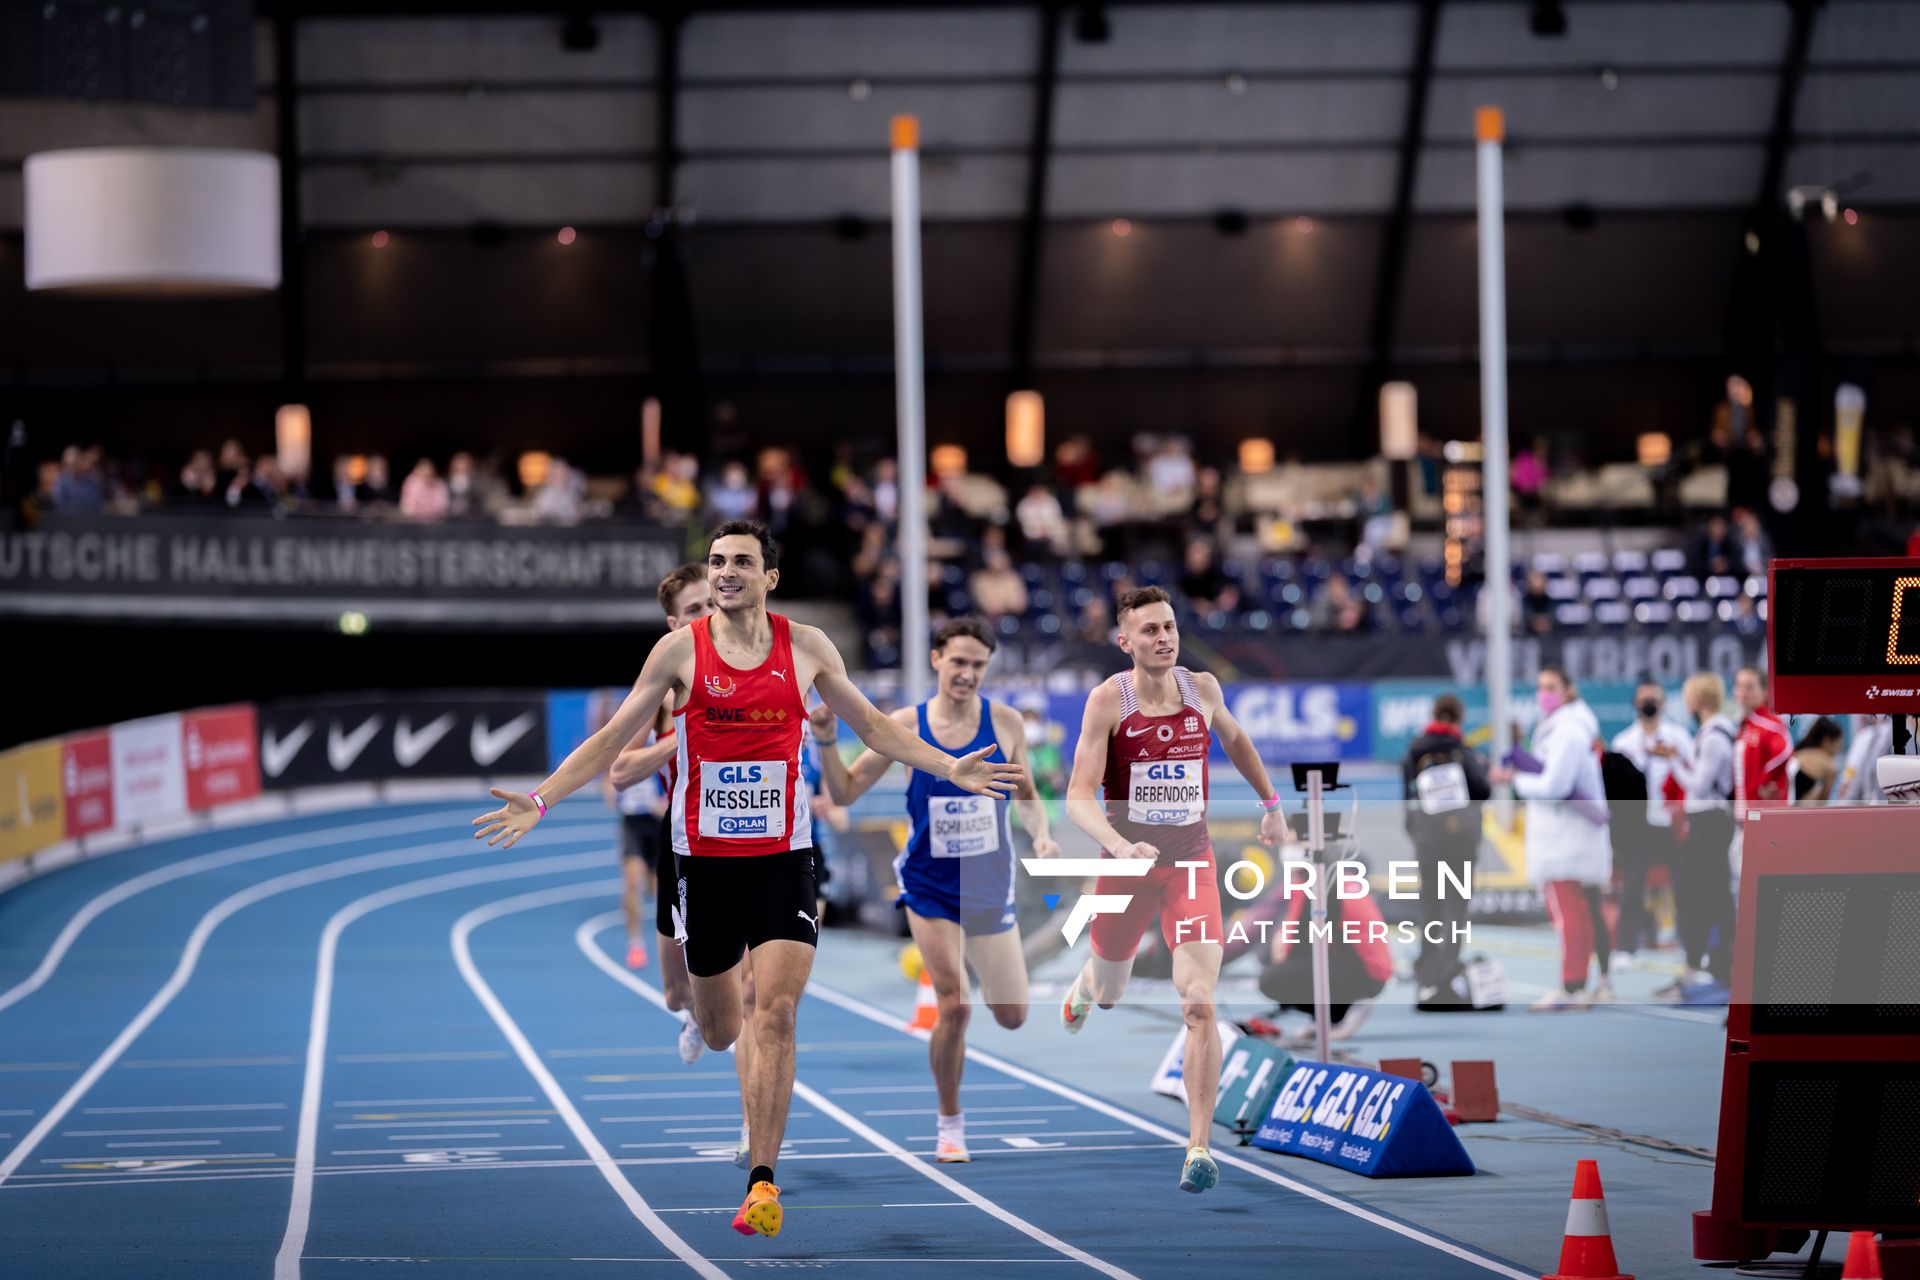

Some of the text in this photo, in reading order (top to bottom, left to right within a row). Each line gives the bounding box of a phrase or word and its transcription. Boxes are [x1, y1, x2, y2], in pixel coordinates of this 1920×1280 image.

[1881, 689, 1914, 697] SWISS
[706, 707, 746, 721] SWE
[705, 788, 781, 810] KESSLER
[1135, 785, 1200, 803] BEBENDORF
[738, 819, 765, 828] PLAN
